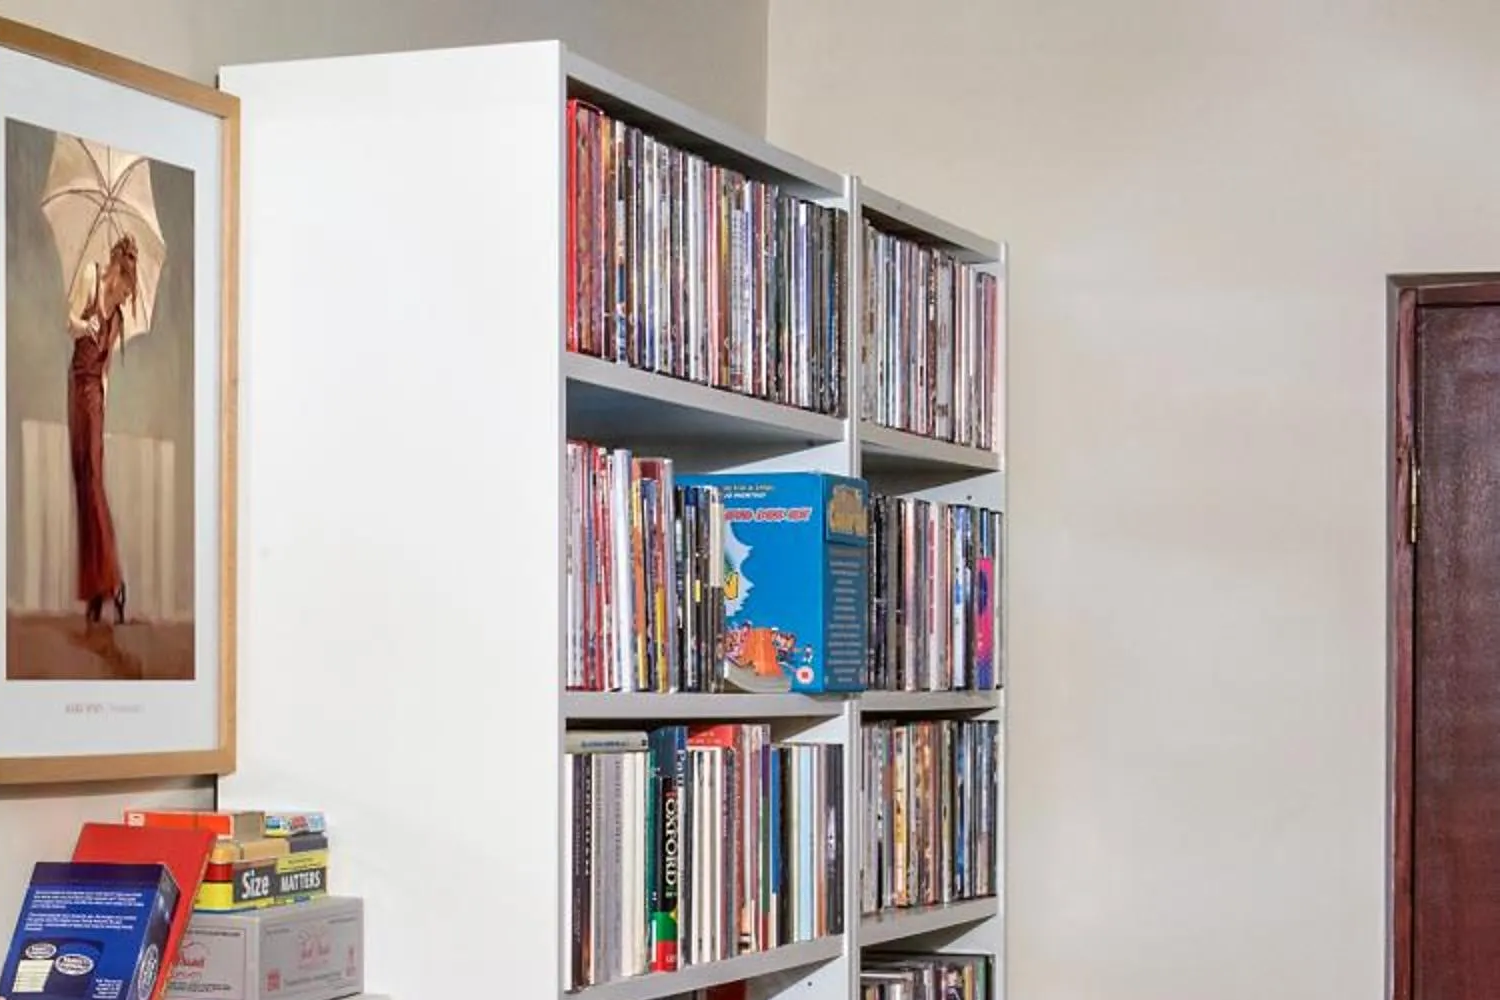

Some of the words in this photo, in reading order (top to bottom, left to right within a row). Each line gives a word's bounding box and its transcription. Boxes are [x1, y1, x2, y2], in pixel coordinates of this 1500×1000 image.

[665, 798, 677, 885] OXFORD
[241, 868, 270, 900] Size
[280, 867, 321, 892] MATTERS
